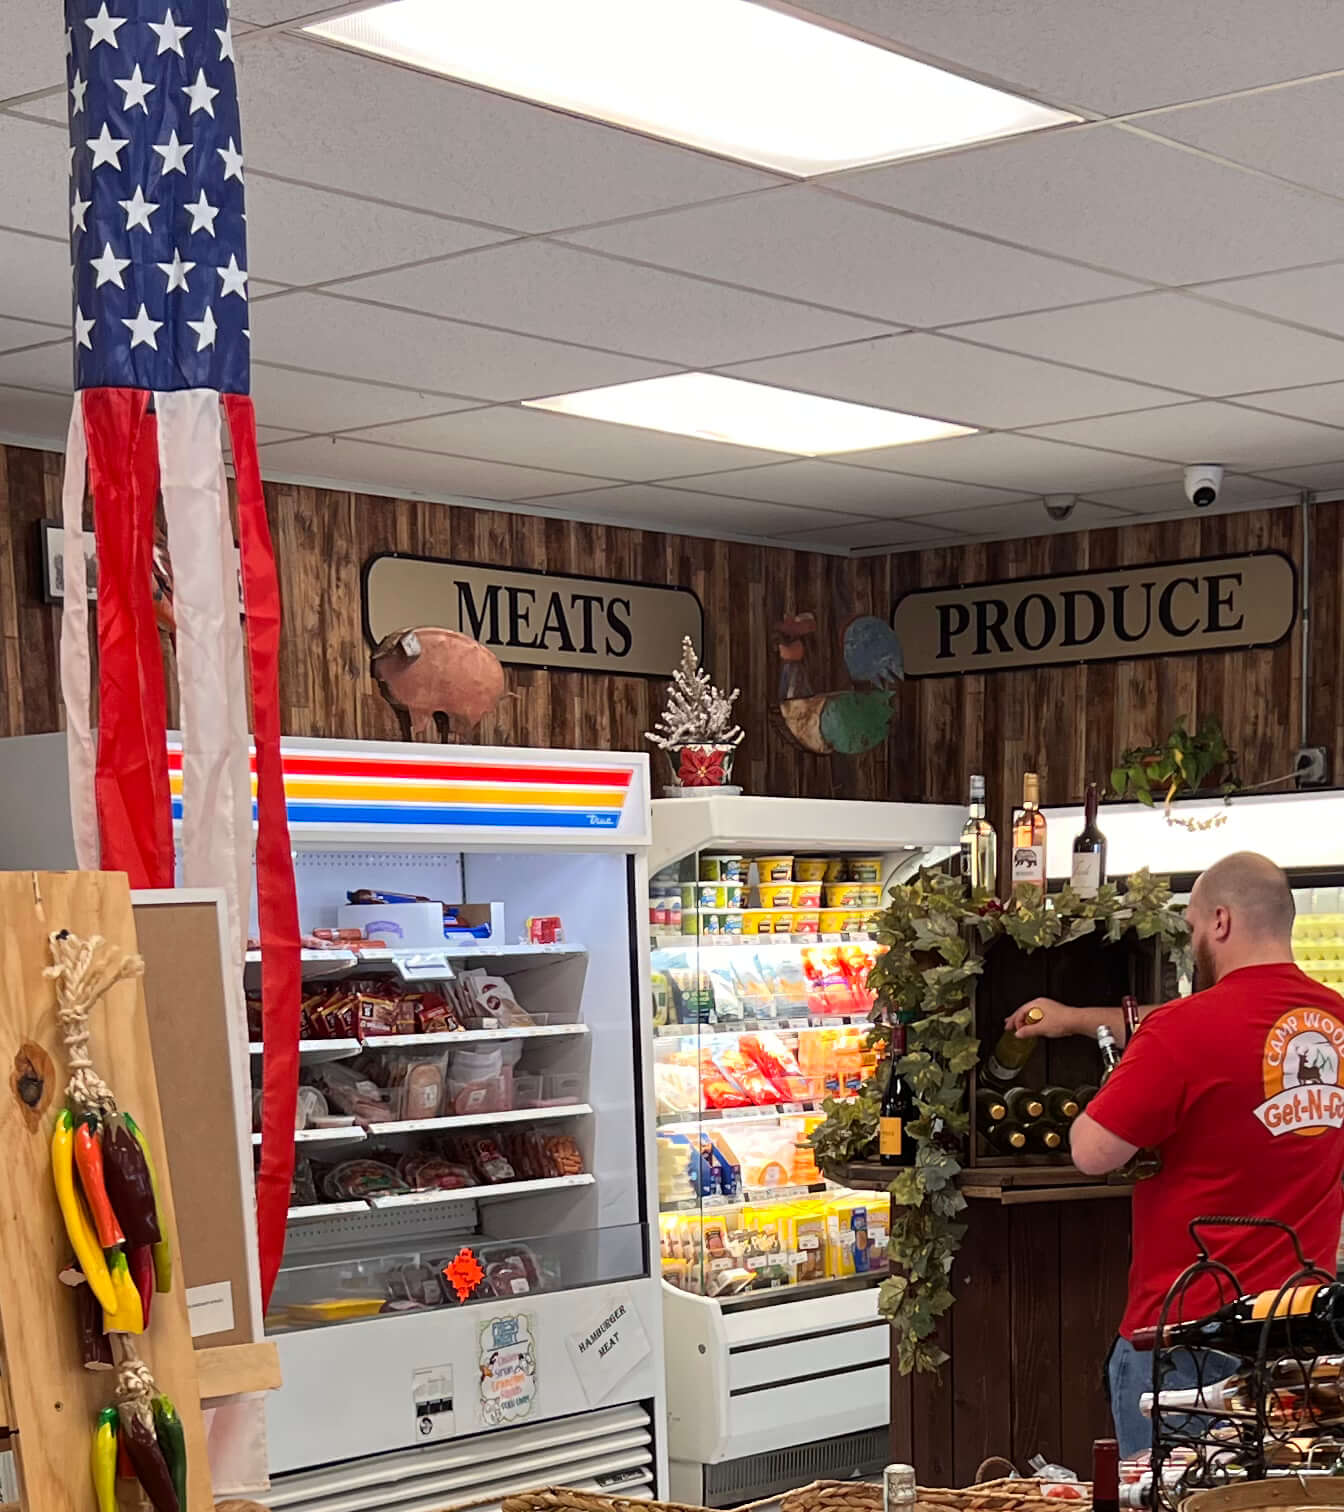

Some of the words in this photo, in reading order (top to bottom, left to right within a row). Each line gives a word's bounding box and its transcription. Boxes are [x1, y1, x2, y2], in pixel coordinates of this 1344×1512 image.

[453, 579, 635, 658] MEATS
[934, 572, 1246, 659] PRODUCE
[1267, 1015, 1299, 1066] CAMP
[577, 1304, 627, 1353] HAMBURGER
[598, 1331, 619, 1359] MEAT
